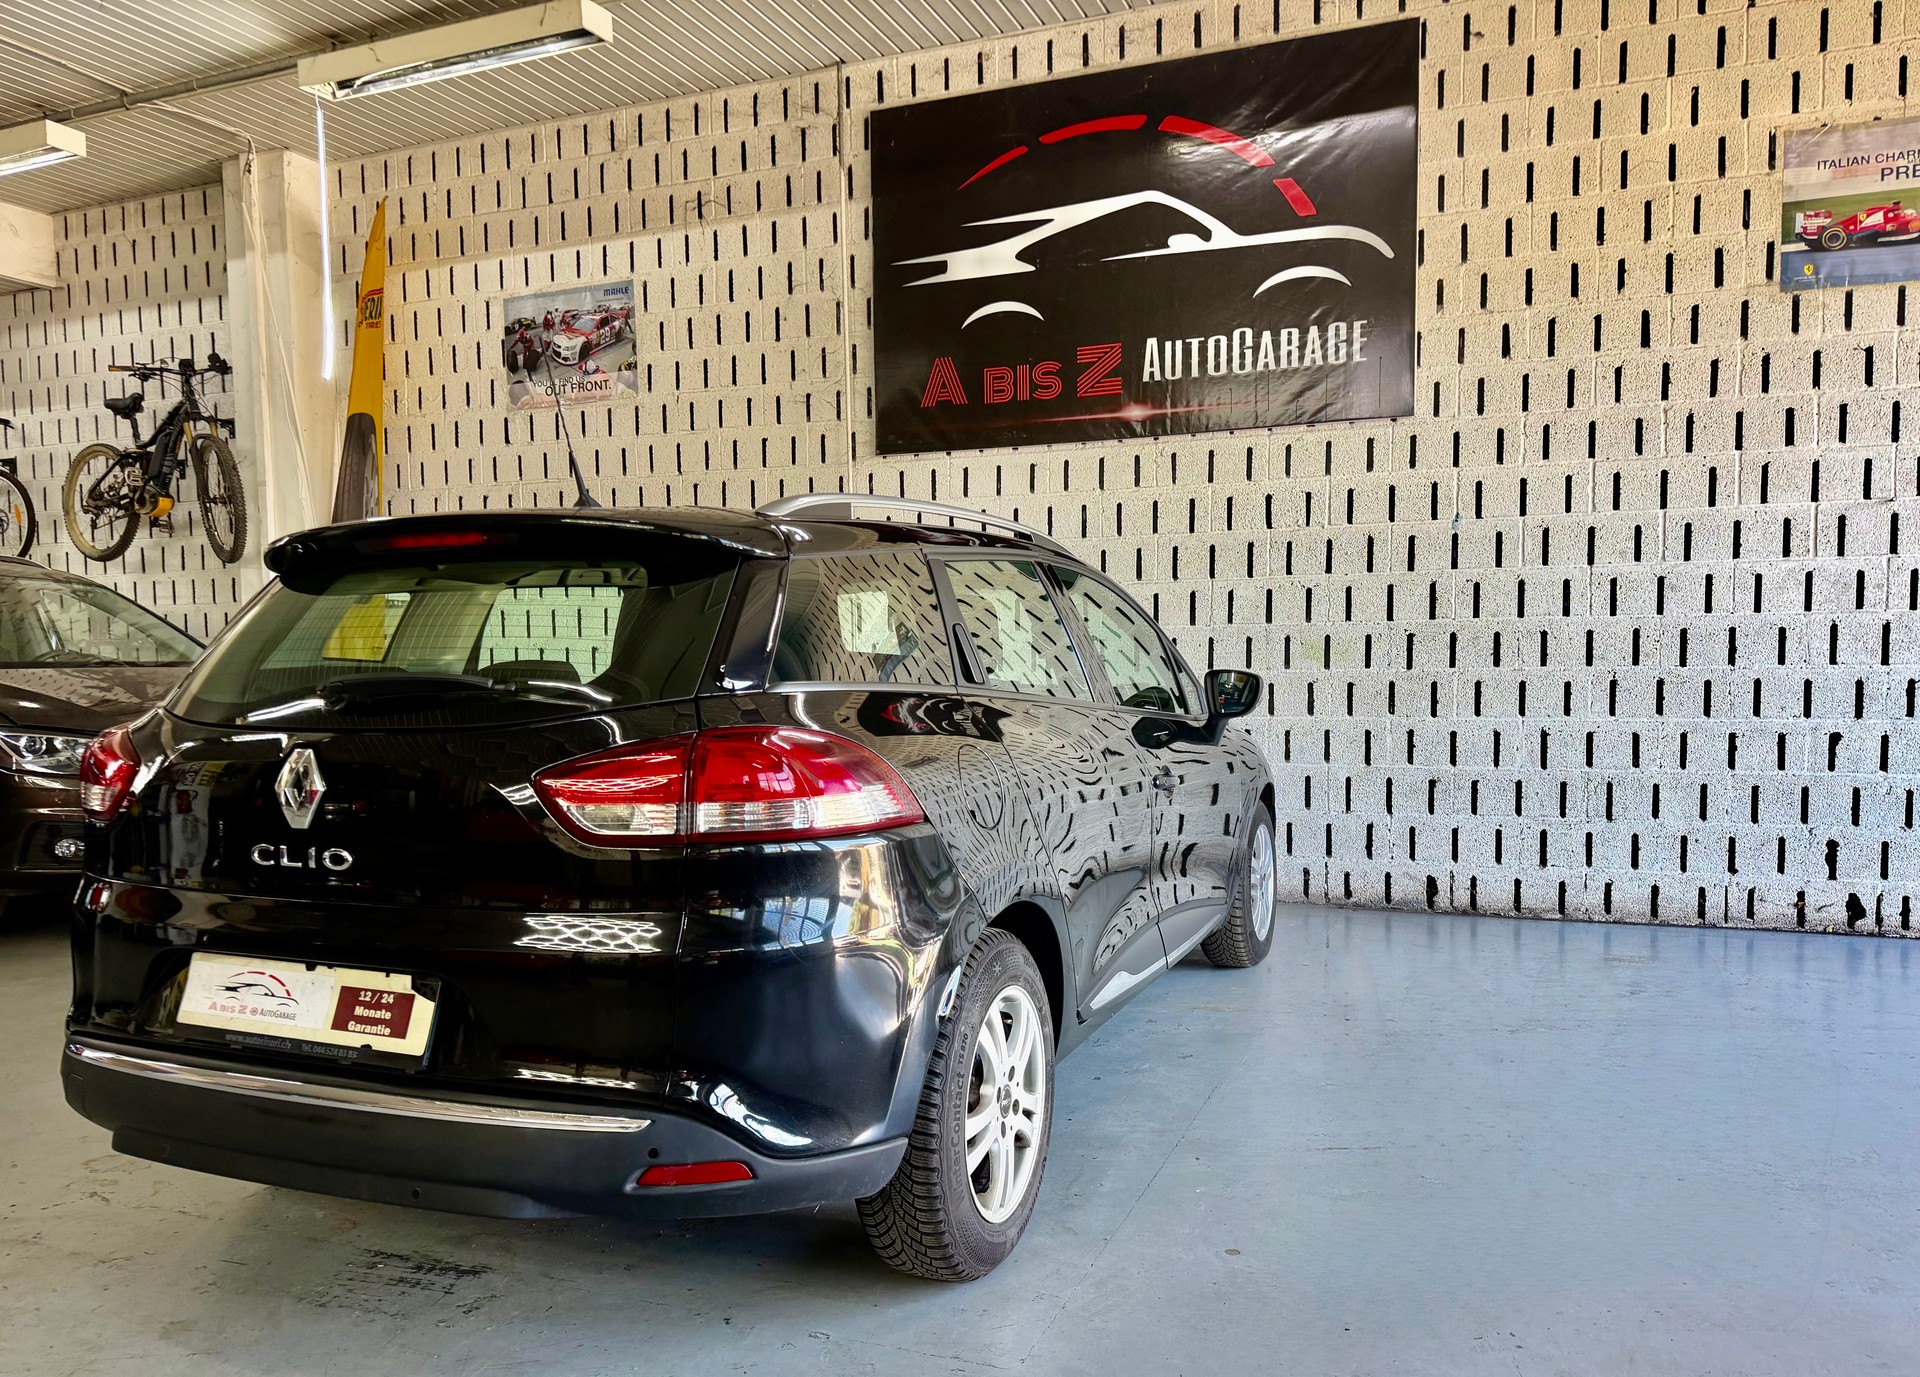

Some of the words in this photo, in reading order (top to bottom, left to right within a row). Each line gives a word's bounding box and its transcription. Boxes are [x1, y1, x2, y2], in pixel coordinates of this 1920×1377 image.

[1817, 155, 1870, 171] ITALIAN
[1875, 149, 1920, 164] CHAR
[603, 286, 629, 297] MAHLE
[559, 377, 574, 385] FIND
[576, 375, 586, 383] US
[920, 357, 968, 408] A
[984, 361, 1063, 404] BIS
[1076, 343, 1122, 398] Z
[545, 384, 568, 397] OUT
[571, 379, 612, 393] FRONT.
[251, 843, 353, 871] CLIO
[358, 991, 371, 1002] 12
[381, 993, 395, 1004] 24
[208, 1001, 217, 1011] A
[219, 1004, 237, 1013] BIS
[238, 1005, 248, 1015] Z
[354, 1006, 392, 1020] Monate
[347, 1020, 391, 1036] Garantie
